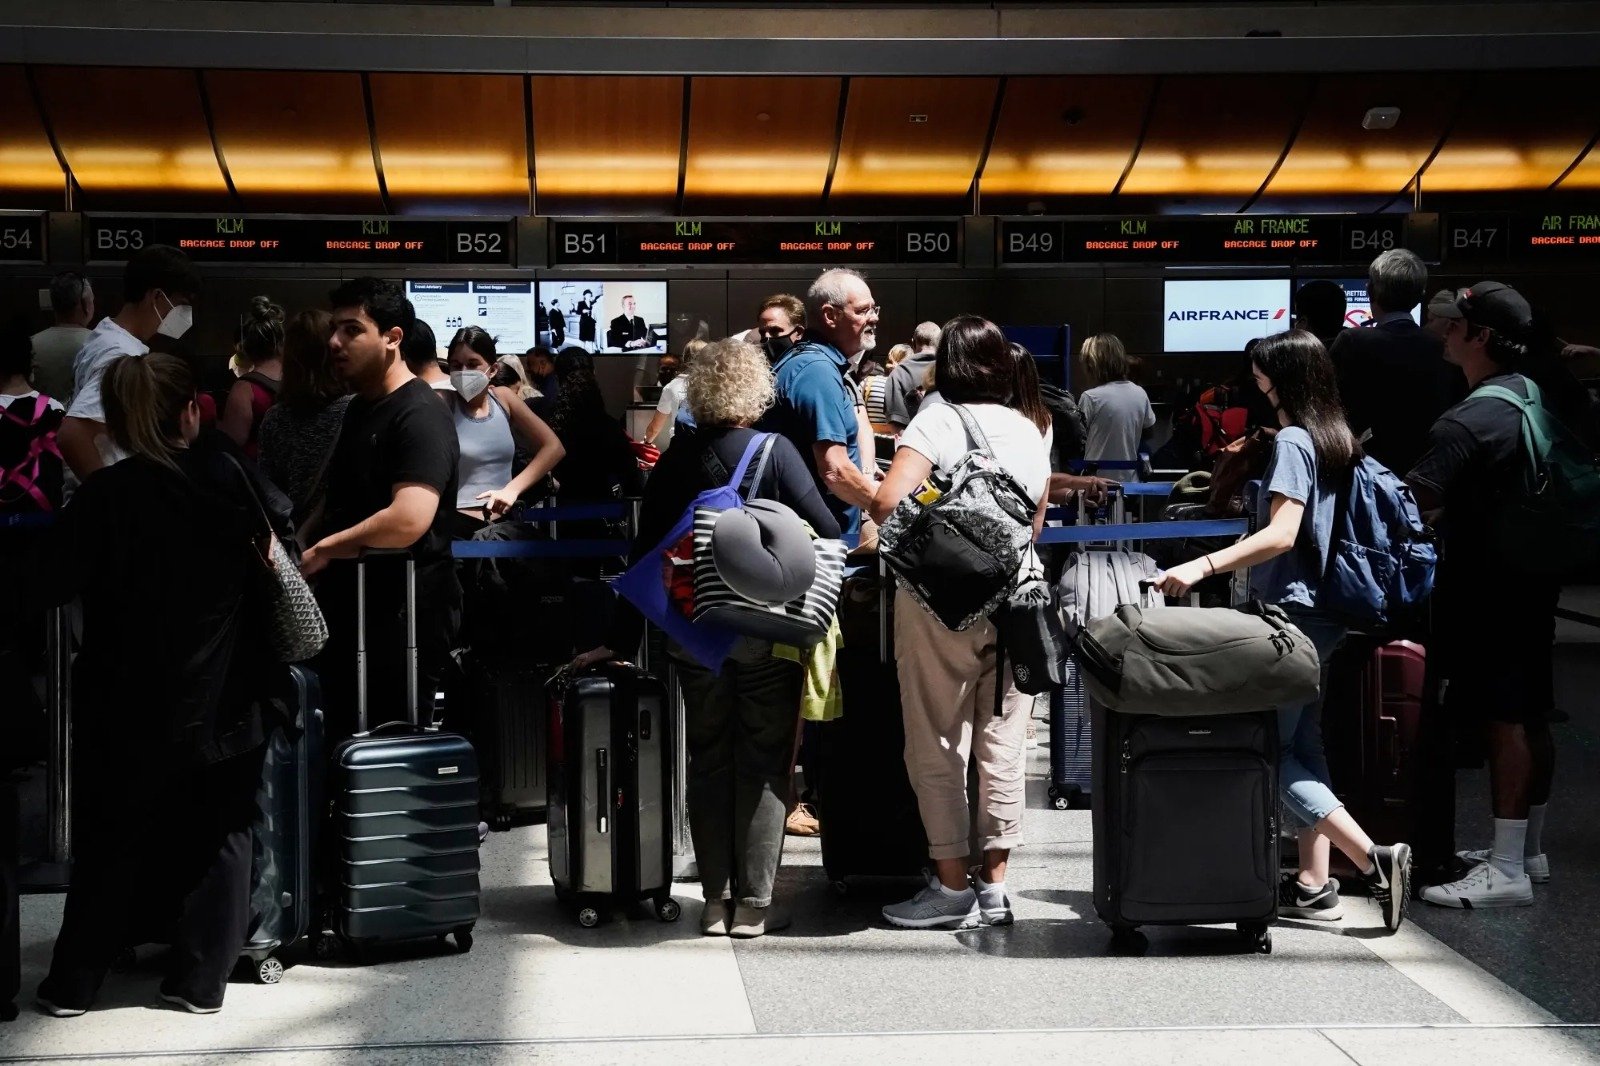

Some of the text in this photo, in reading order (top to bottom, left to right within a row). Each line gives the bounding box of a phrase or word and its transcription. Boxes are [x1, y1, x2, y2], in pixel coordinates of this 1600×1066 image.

[217, 219, 243, 233] KLM
[362, 220, 388, 235] KLM
[676, 221, 702, 236] KLM
[815, 221, 841, 236] KLM
[1121, 220, 1147, 235] KLM
[1234, 219, 1309, 234] AIR FRANCE
[1541, 215, 1562, 230] AIR
[0, 229, 32, 248] 54
[97, 229, 144, 249] B53
[180, 239, 280, 248] BAGGAGE DROP OFF
[326, 241, 424, 249] BAGGAGE DROP OFF
[457, 232, 502, 253] B52
[564, 233, 606, 254] B51
[907, 232, 950, 253] B50
[1009, 232, 1053, 253] B49
[1085, 241, 1180, 249] BAGGAGE DROP OFF
[1224, 240, 1319, 248] BAGGAGE DROP OFF
[1351, 229, 1394, 249] B48
[1453, 228, 1498, 248] B47
[640, 242, 736, 250] BAGGAGE DROP OFF
[780, 242, 875, 250] BAGGAGE DROP OFF
[1168, 309, 1269, 321] AIRFRANCE
